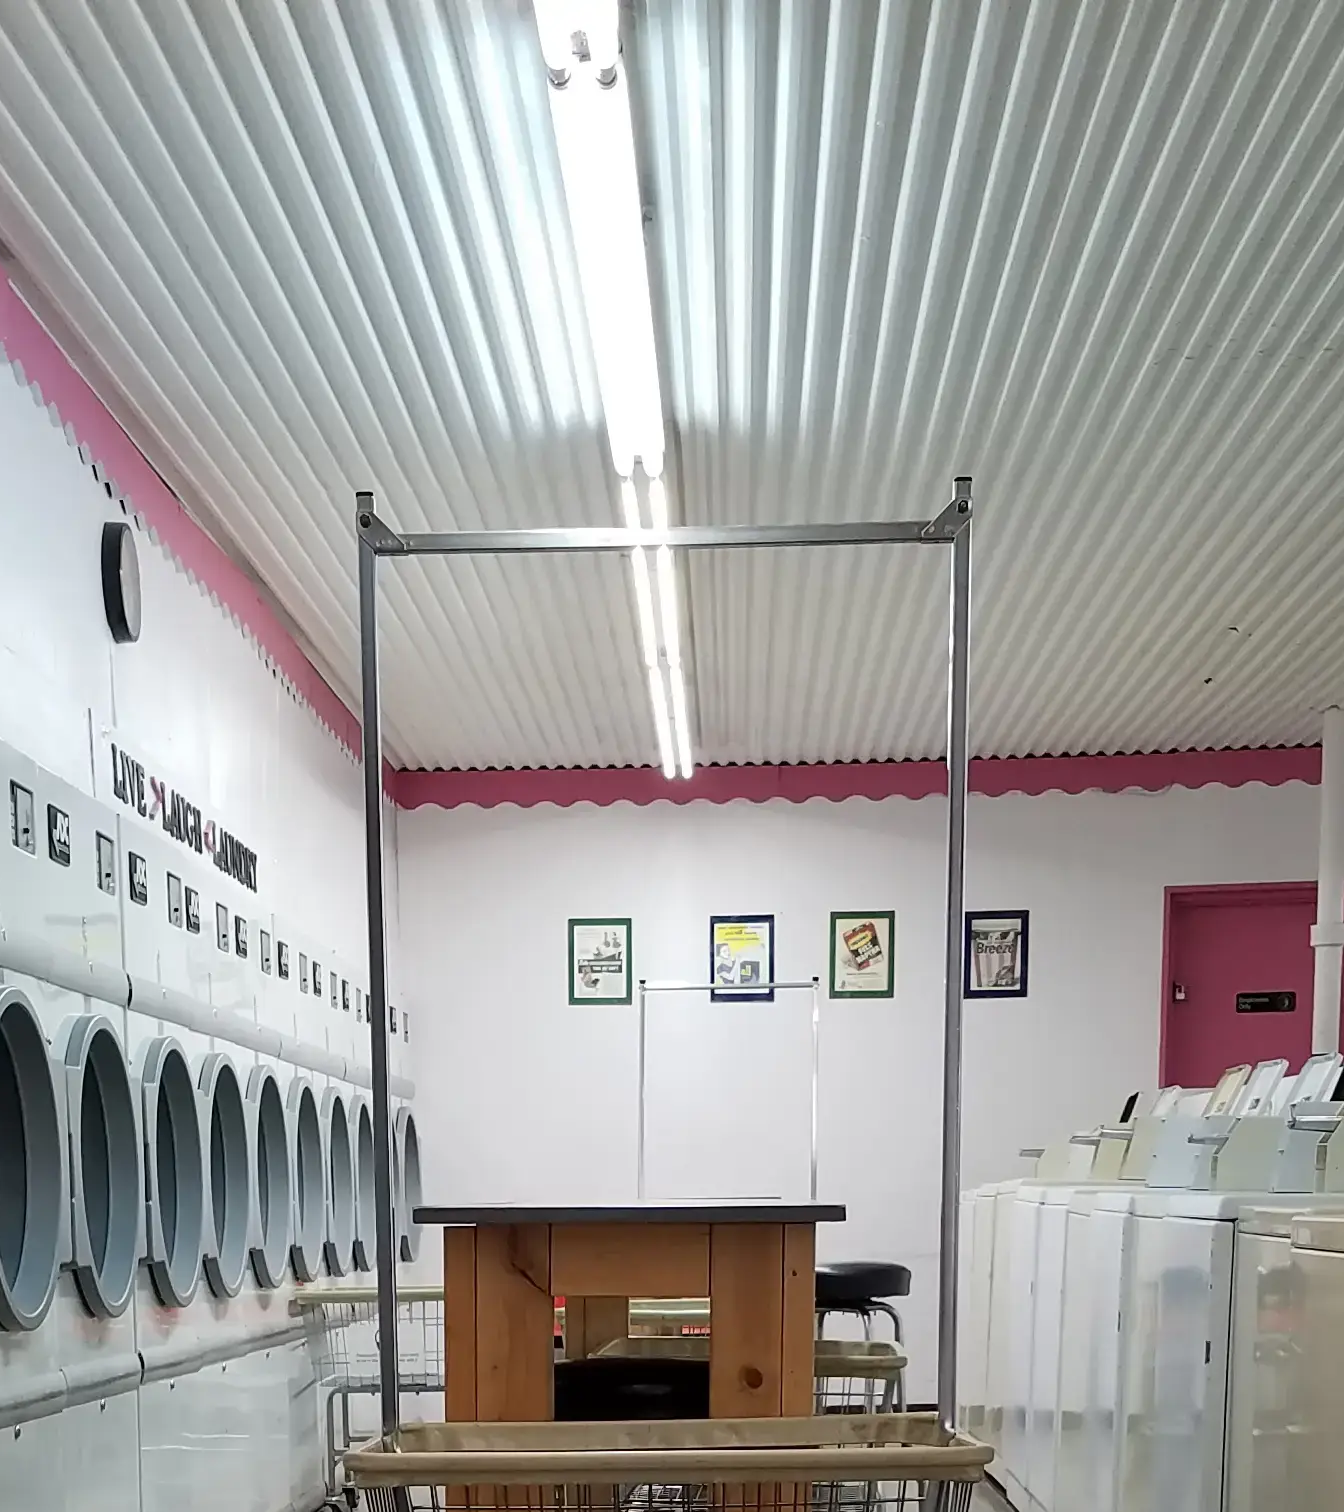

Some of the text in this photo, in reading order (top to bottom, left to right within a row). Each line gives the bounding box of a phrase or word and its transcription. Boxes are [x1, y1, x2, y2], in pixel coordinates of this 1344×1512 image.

[111, 742, 257, 894] LIVE LAUGH LAUNDRY
